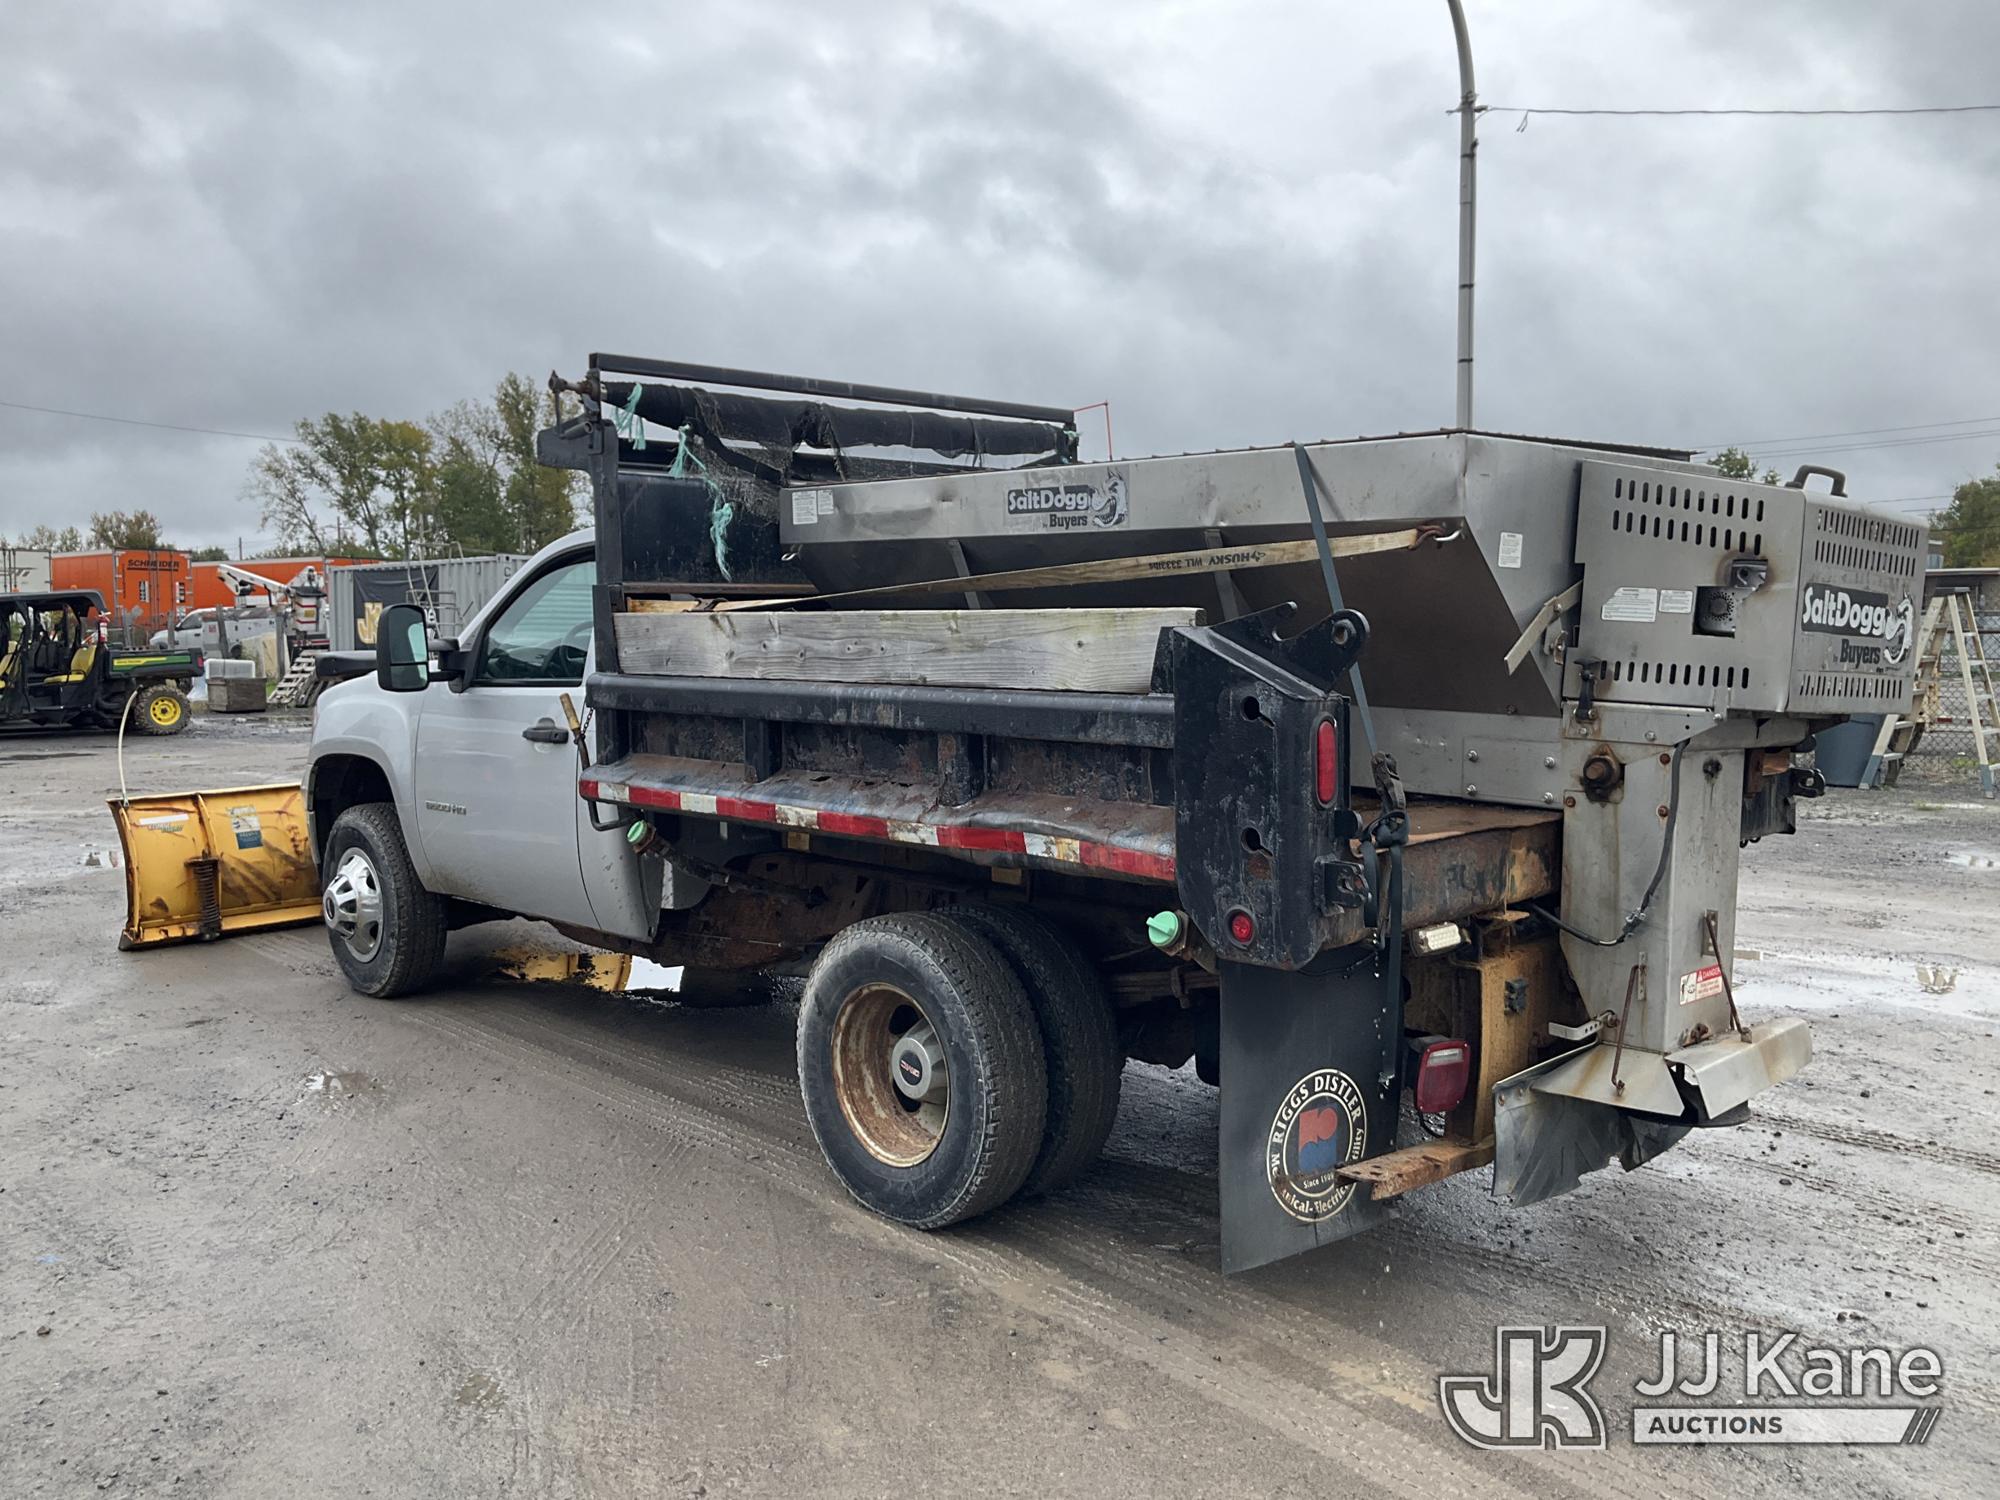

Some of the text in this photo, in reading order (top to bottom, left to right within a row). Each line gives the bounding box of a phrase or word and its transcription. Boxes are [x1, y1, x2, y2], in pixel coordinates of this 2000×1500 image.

[1008, 487, 1090, 511] SaltDogg
[1049, 513, 1088, 530] Buyers
[1185, 557, 1202, 568] WLL
[1208, 551, 1251, 566] HUSKY
[1803, 587, 1885, 636] SaltDogg
[1840, 638, 1881, 669] Buyers
[1272, 1074, 1363, 1144] RIGGS DISTLER
